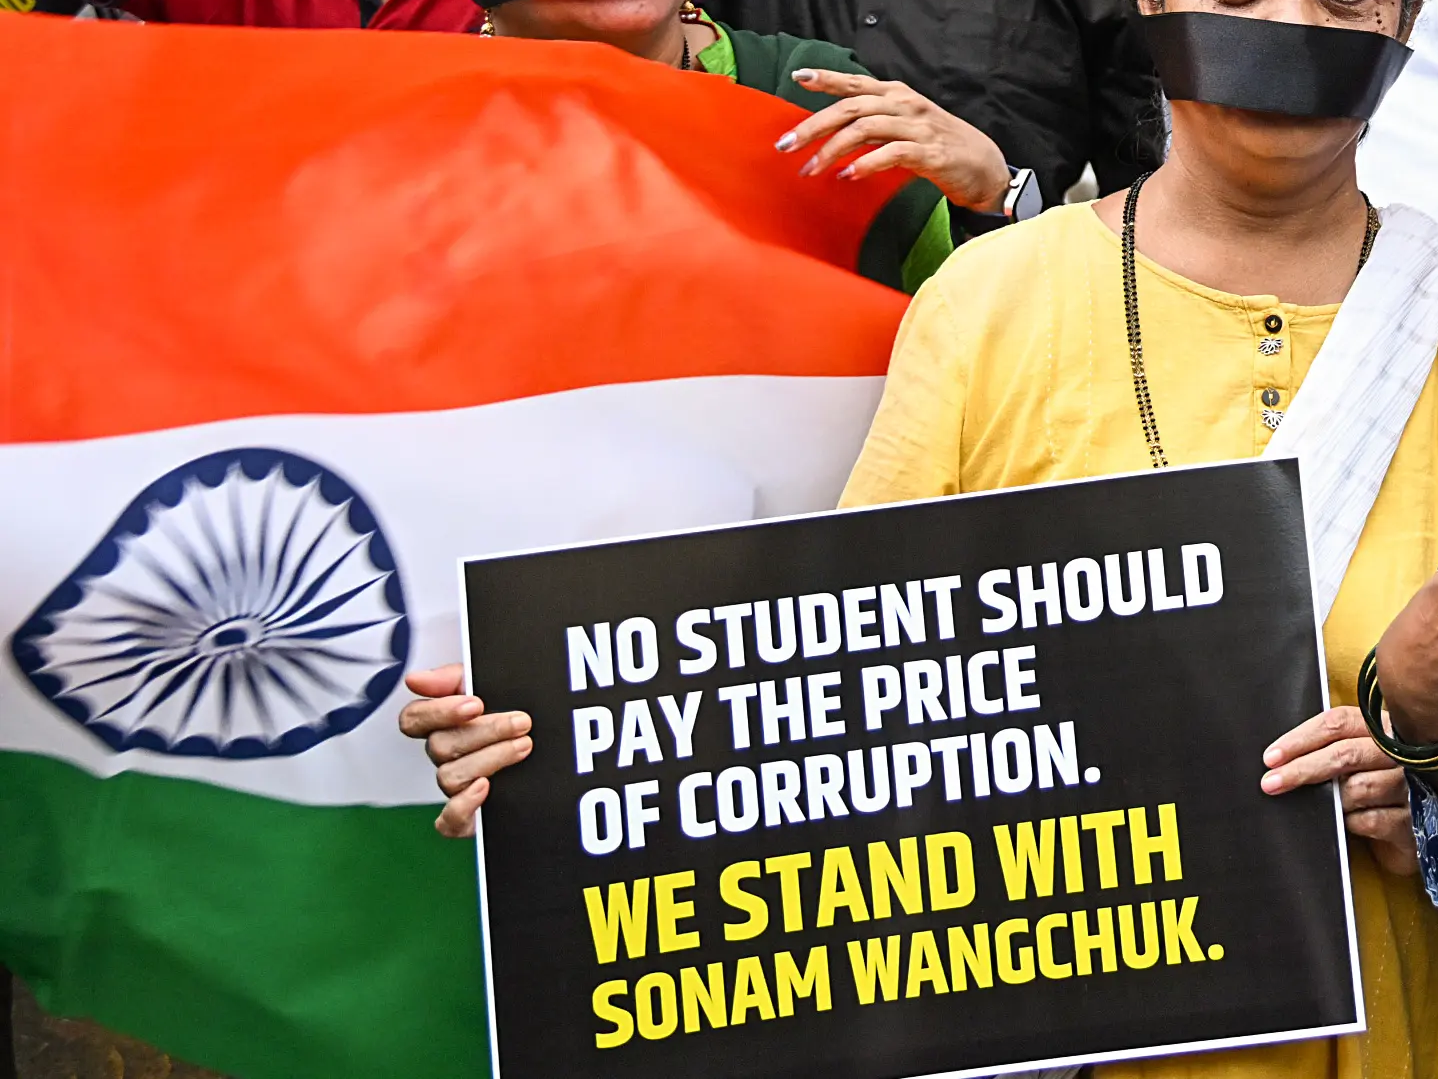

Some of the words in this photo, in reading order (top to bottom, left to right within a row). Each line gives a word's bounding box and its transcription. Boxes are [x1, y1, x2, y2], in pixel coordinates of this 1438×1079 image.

[566, 617, 660, 692] NO
[675, 574, 963, 676] STUDENT
[978, 541, 1226, 636] SHOULD
[571, 689, 704, 776] PAY
[718, 662, 846, 752] THE
[863, 644, 1042, 732] PRICE
[579, 783, 661, 857] OF
[676, 720, 1102, 839] CORRUPTION.
[582, 869, 701, 965] WE
[720, 831, 977, 943] STAND
[992, 802, 1184, 901] WITH
[591, 943, 832, 1050] SONAM
[848, 895, 1226, 1007] WANGCHUK.
